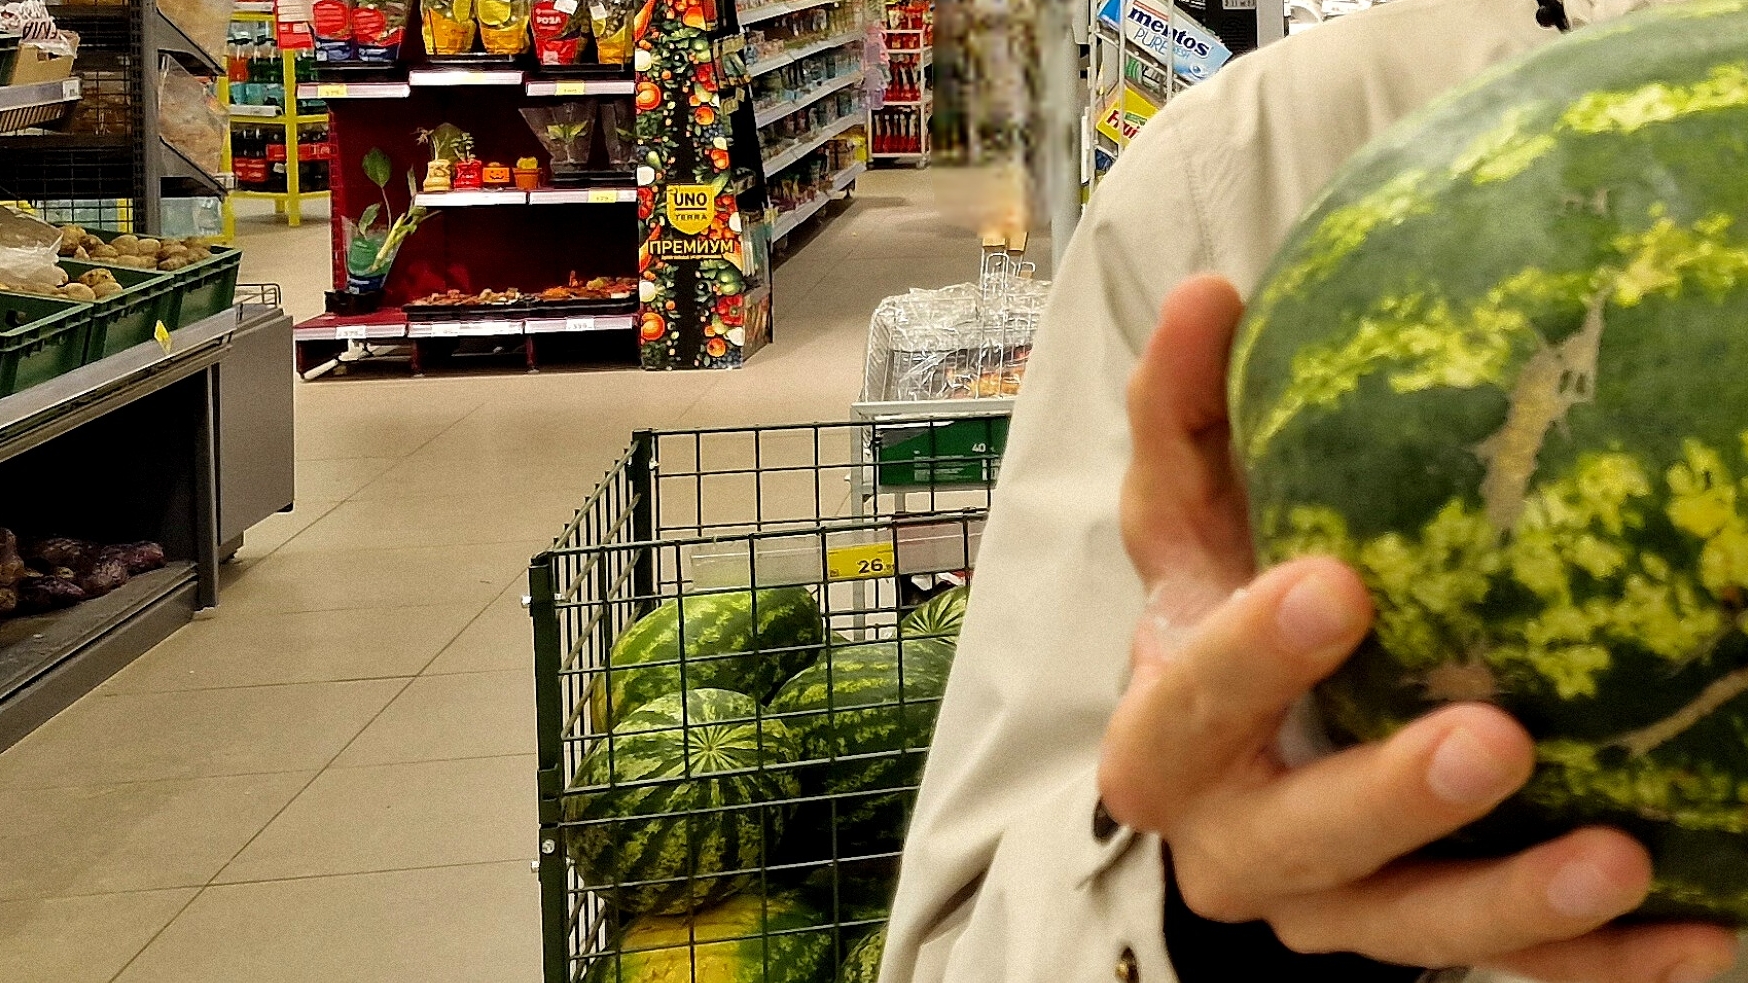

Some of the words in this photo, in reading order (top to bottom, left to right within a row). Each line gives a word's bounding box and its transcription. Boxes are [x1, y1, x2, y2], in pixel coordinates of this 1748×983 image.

[1128, 6, 1212, 57] mentos
[1134, 26, 1168, 56] PURE
[674, 192, 707, 206] UNO
[649, 239, 734, 255] ПРЕМИУМ
[971, 442, 987, 454] 40
[857, 558, 884, 575] 26
